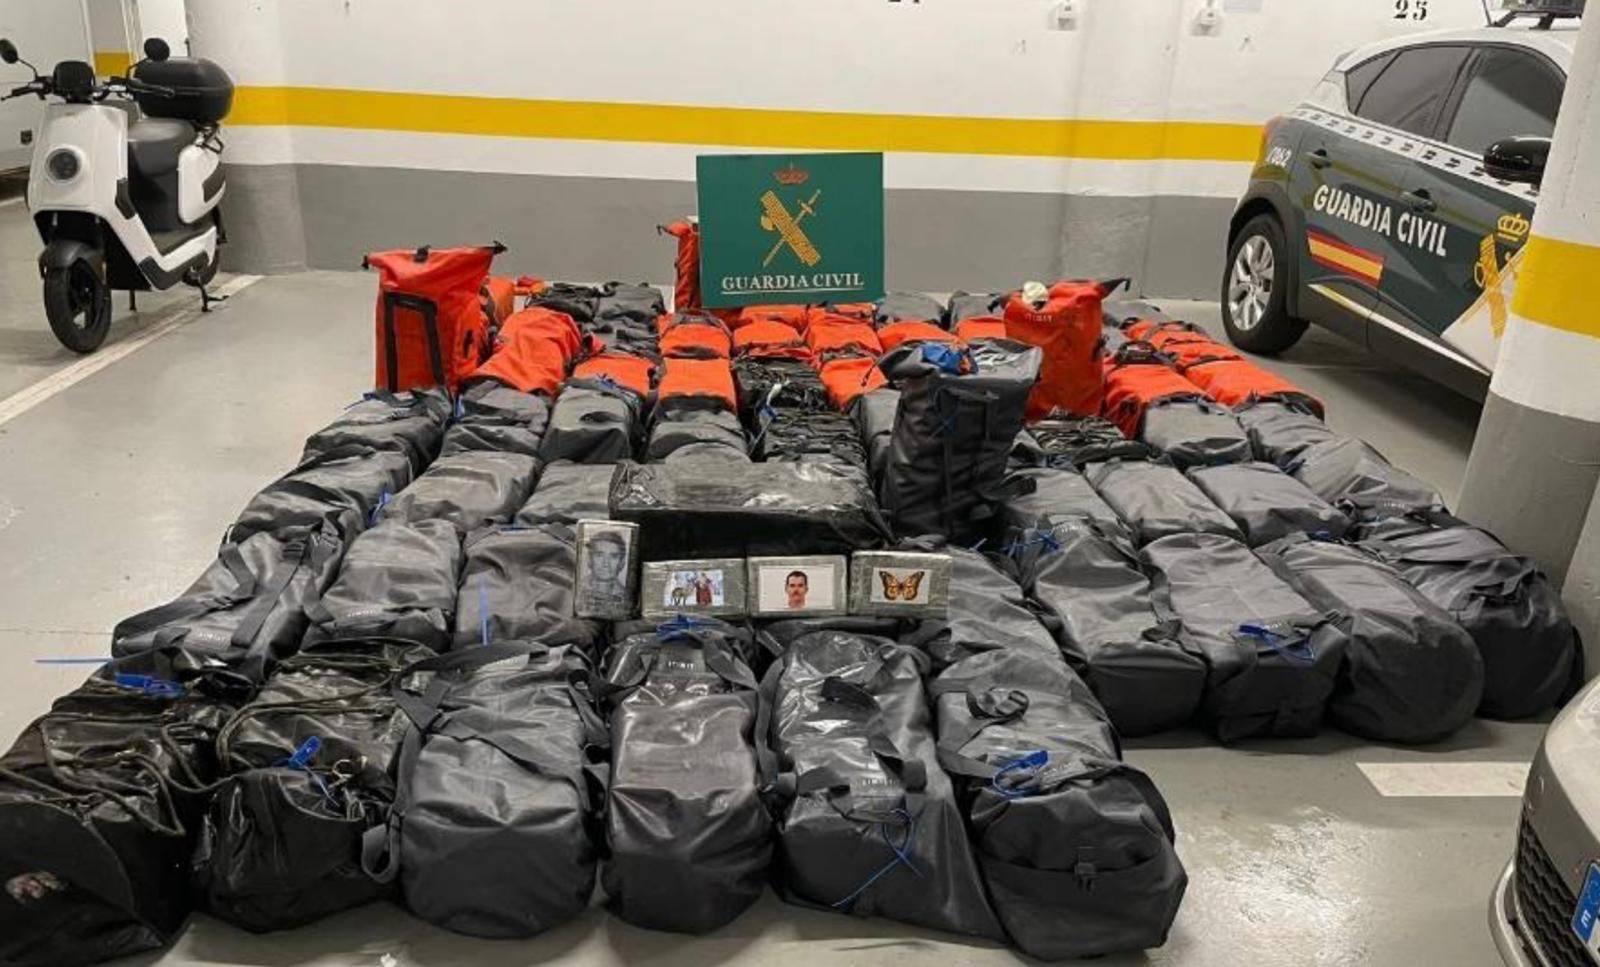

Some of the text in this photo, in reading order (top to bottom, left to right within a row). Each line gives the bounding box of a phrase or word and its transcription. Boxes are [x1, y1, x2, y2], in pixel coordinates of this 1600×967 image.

[1393, 0, 1427, 20] 25
[1313, 184, 1447, 257] GUARDIA CIVIL
[721, 272, 864, 290] GUARDIA CIVIL
